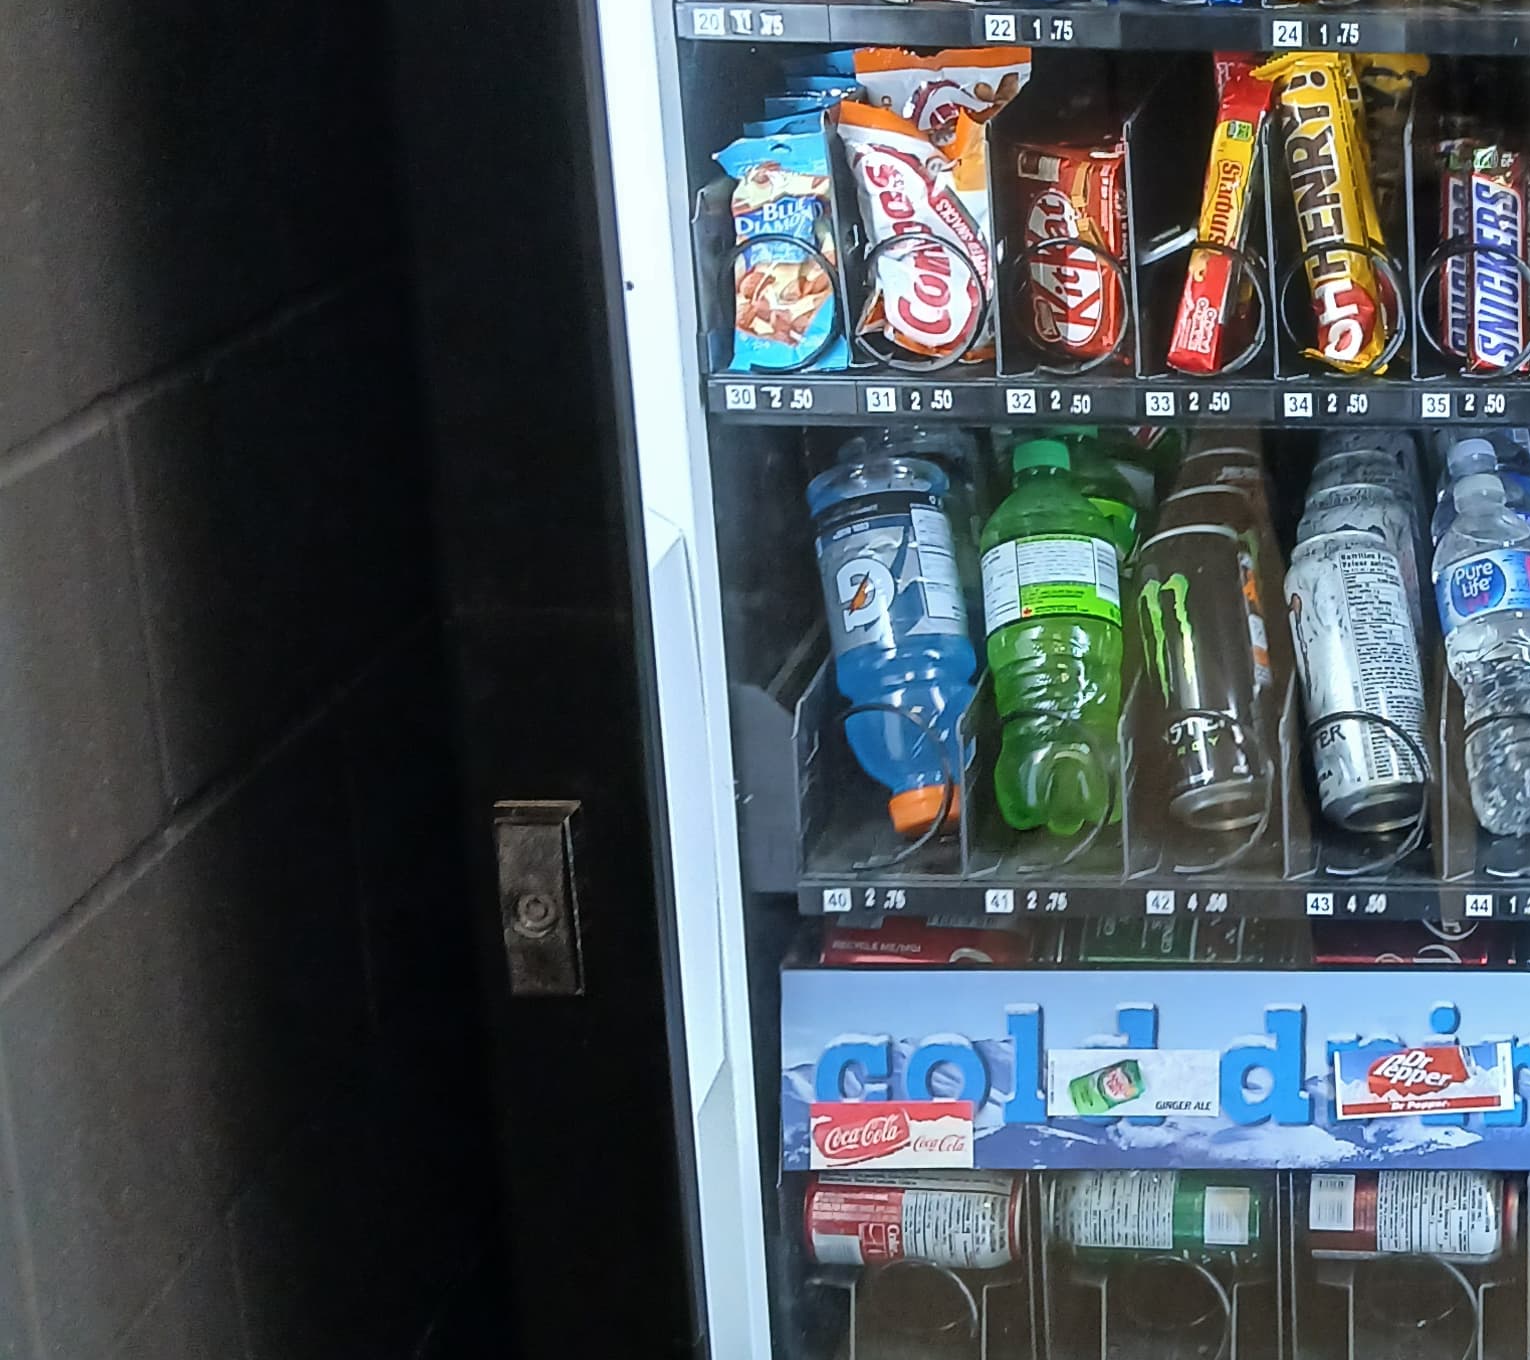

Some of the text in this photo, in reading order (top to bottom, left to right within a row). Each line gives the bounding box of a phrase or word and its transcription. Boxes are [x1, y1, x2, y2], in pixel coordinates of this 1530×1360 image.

[990, 19, 1011, 37] 22
[1278, 25, 1299, 43] 24
[762, 197, 808, 223] BLUE
[1206, 159, 1242, 251] Starburs
[1284, 70, 1366, 363] OH HENRY!
[1472, 174, 1522, 367] SNICKERS
[730, 388, 751, 406] 30
[871, 391, 891, 408] 31
[1011, 392, 1032, 409] 32
[1150, 395, 1170, 412] 33
[1289, 397, 1308, 413] 34
[1428, 397, 1447, 413] 35
[1454, 561, 1494, 586] Pure
[1461, 578, 1491, 598] Life
[828, 892, 847, 908] 40
[990, 893, 1008, 910] 41
[1151, 895, 1170, 910] 42
[1310, 896, 1330, 912] 43
[1470, 898, 1489, 913] 44
[831, 940, 879, 952] RECYCLE
[1401, 1050, 1434, 1069] Dr
[1373, 1054, 1454, 1088] Pepper
[1155, 1100, 1213, 1112] GINGER ALE
[1390, 1099, 1450, 1111] Dr Pepper
